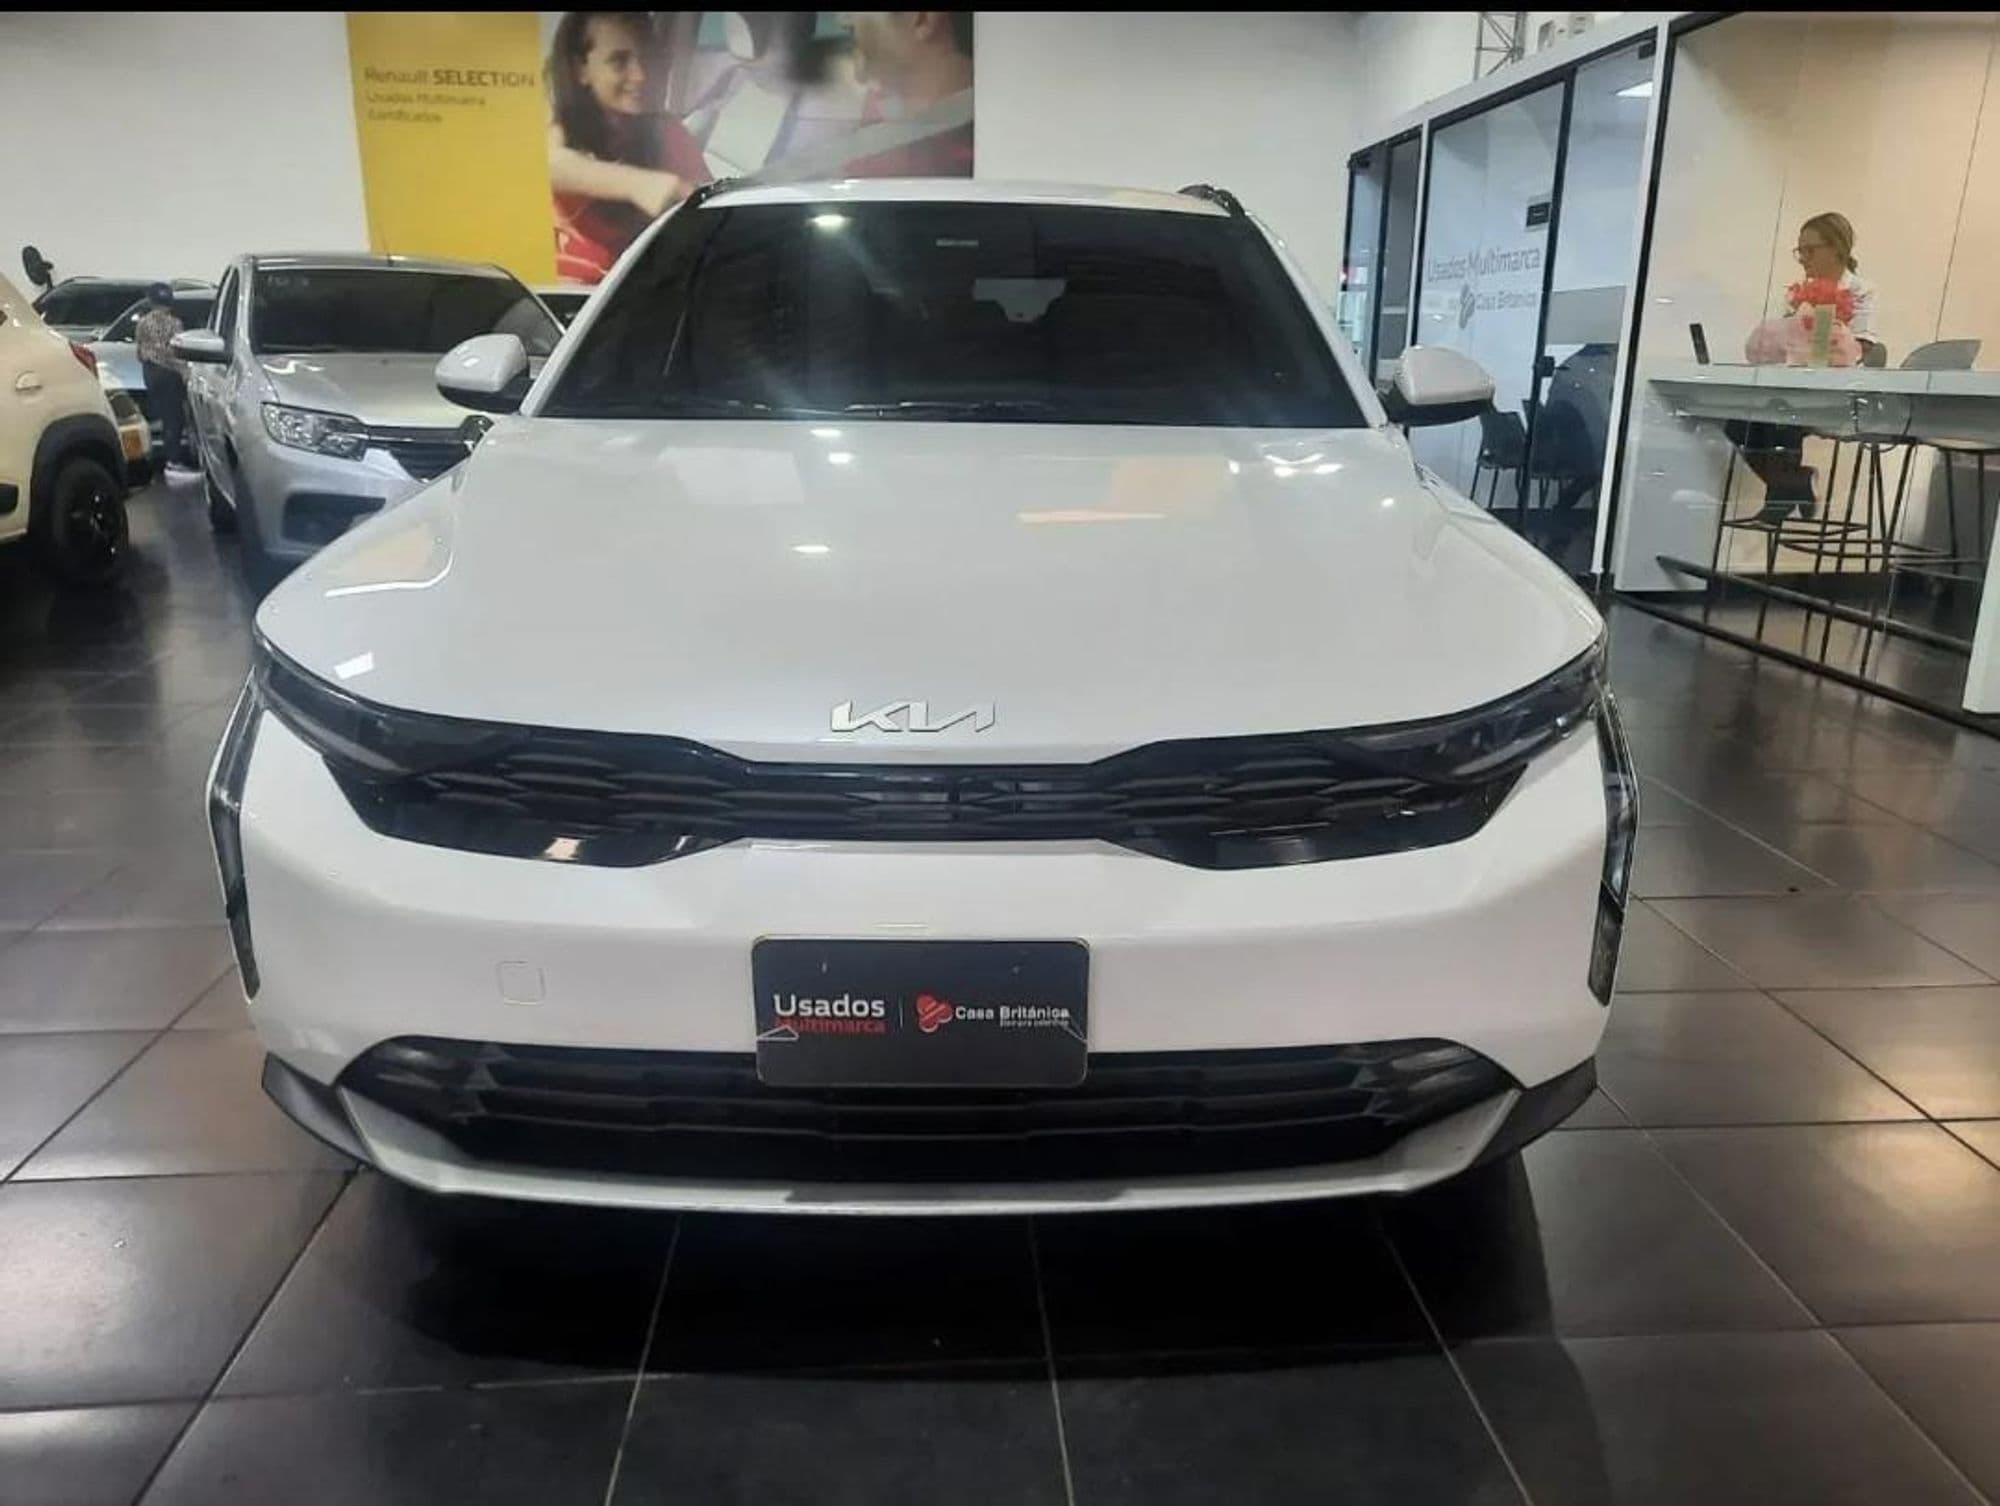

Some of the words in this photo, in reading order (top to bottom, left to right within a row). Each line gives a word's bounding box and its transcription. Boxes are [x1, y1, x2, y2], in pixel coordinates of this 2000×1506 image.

[432, 69, 535, 87] SELECTION
[1468, 246, 1541, 277] Multimarca
[831, 700, 996, 733] KIA
[773, 993, 886, 1017] Usados
[955, 1006, 994, 1020] Casa
[1000, 1005, 1070, 1020] Británica
